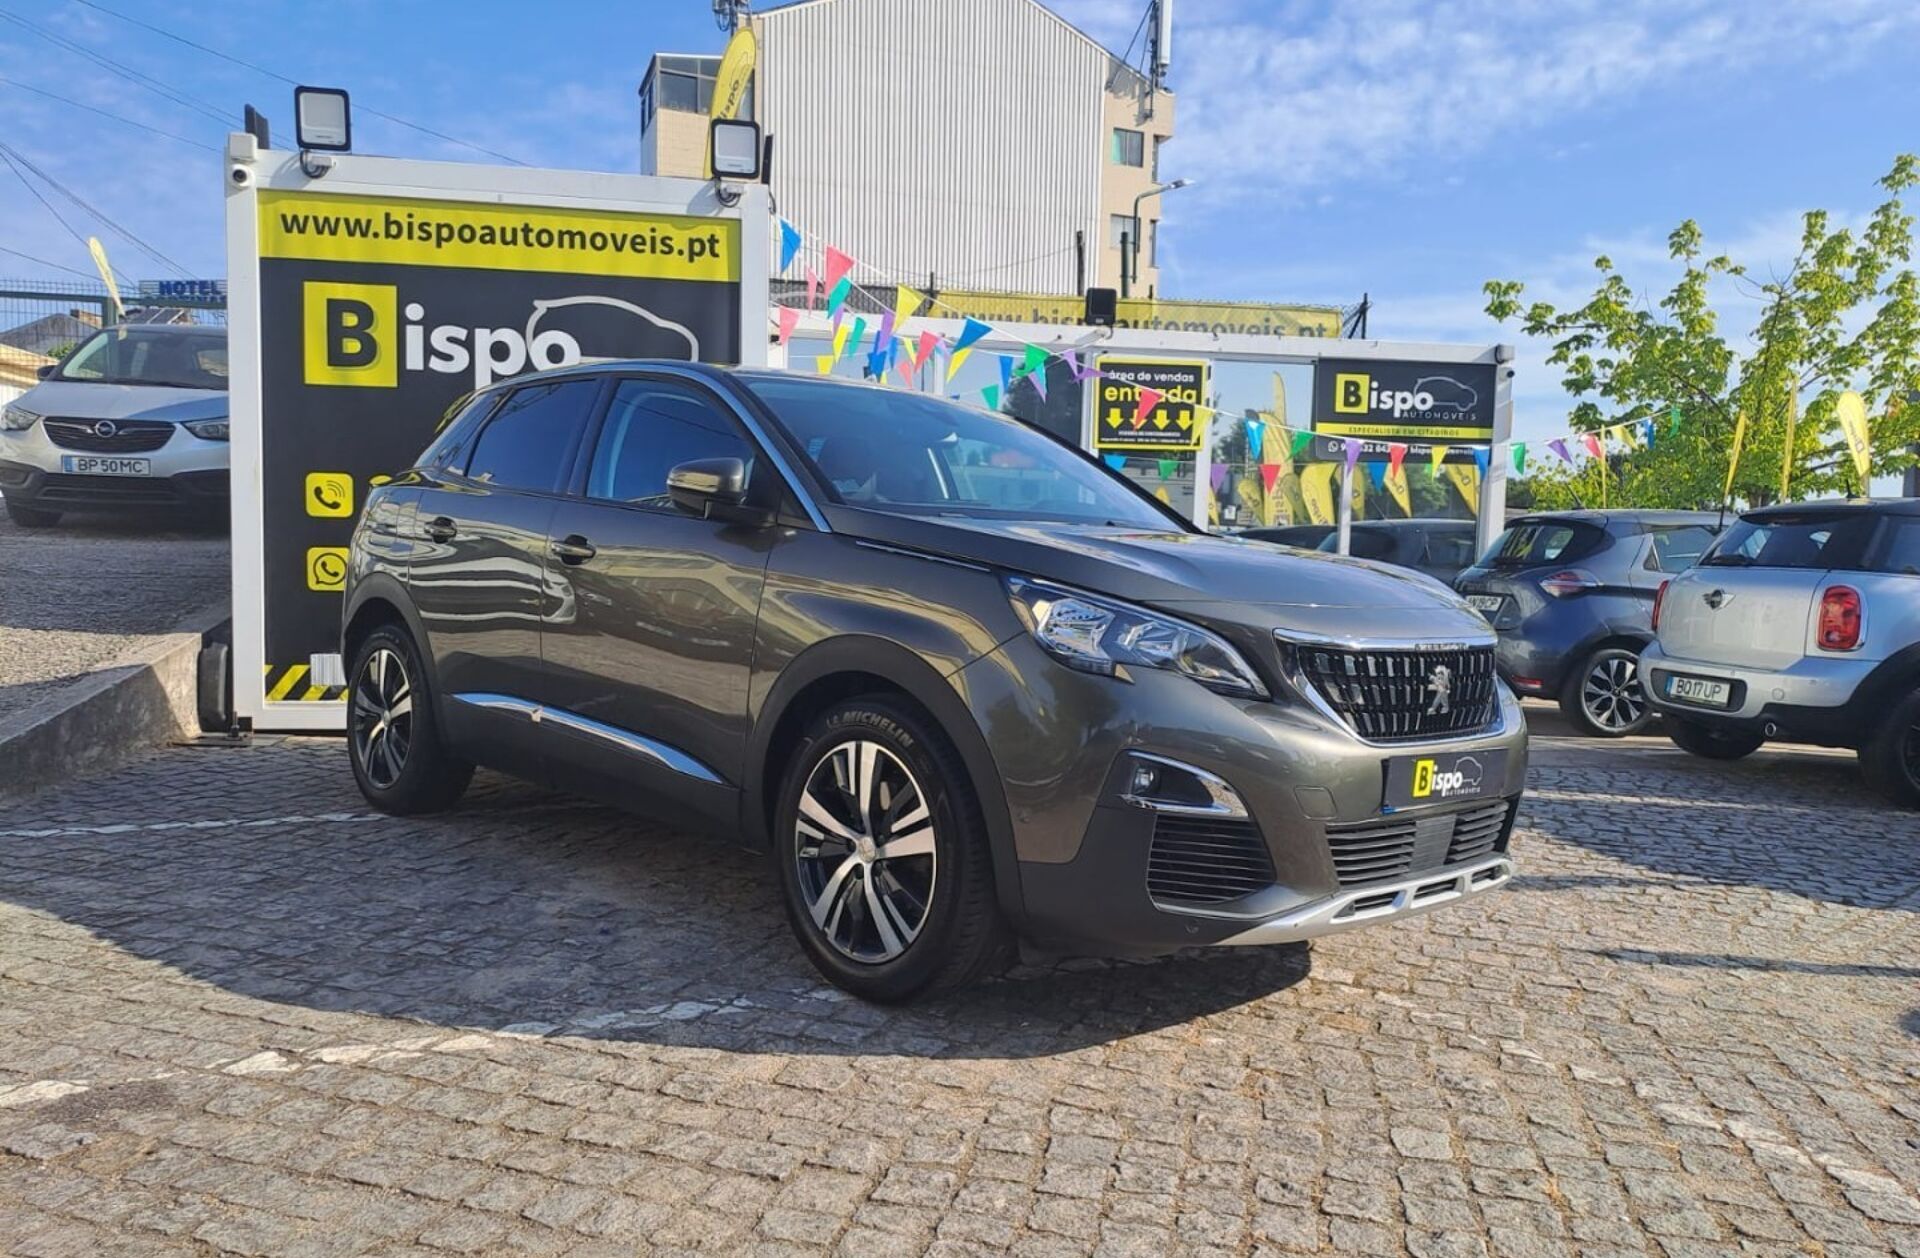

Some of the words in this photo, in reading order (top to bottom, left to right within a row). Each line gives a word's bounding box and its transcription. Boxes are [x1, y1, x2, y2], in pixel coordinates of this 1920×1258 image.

[280, 211, 721, 264] www.bispoautomoveis.pt
[160, 280, 222, 296] HOTEL
[326, 296, 582, 391] Bispo
[1137, 372, 1152, 381] de
[1154, 372, 1195, 382] vendas
[1343, 380, 1434, 418] Bispo
[78, 459, 98, 471] BP
[100, 460, 118, 472] 50
[120, 461, 143, 473] MC
[1703, 682, 1722, 699] UP
[842, 711, 915, 748] MICHELIN
[1418, 764, 1464, 797] Bispo
